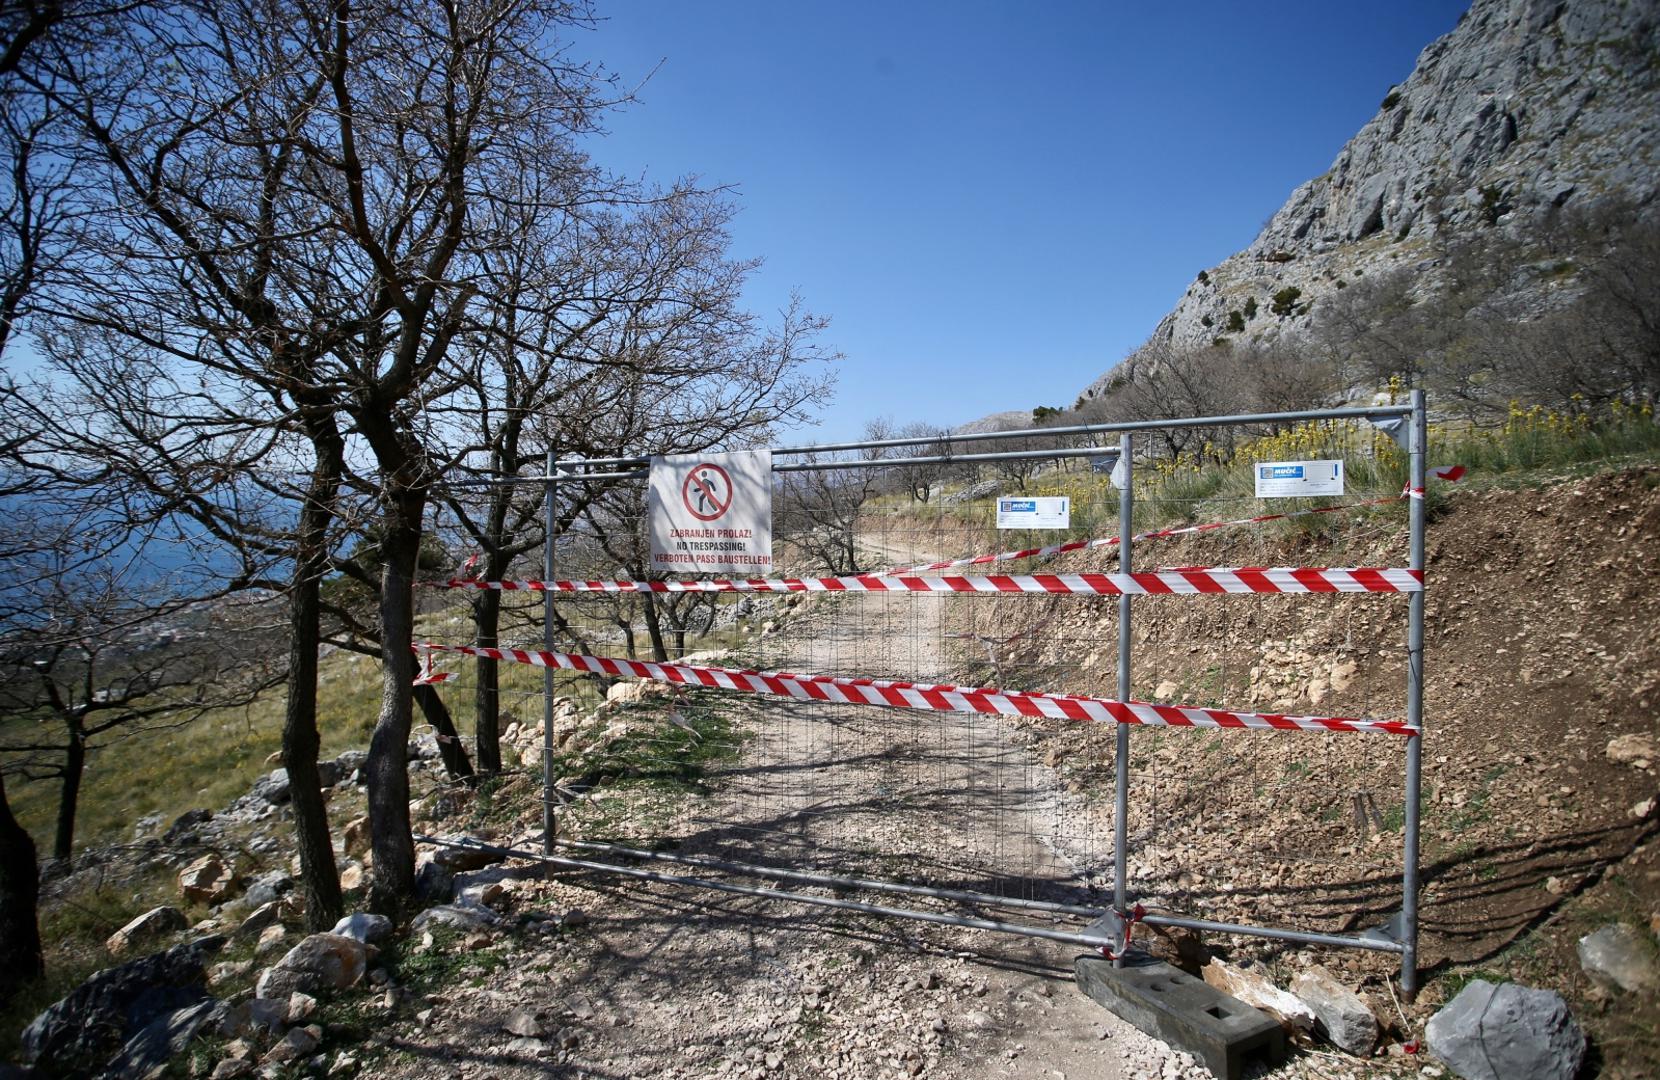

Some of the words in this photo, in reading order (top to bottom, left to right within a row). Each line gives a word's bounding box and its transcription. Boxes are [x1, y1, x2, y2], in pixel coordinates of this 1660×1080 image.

[670, 529, 715, 538] ZABRANJEN
[718, 529, 752, 539] PROLAZ!
[677, 542, 687, 551] NO
[690, 542, 746, 551] TRESPASSING!
[655, 554, 693, 562] VERBOTEN
[696, 555, 715, 563] PASS
[718, 555, 771, 565] BAUSTELLEN!
